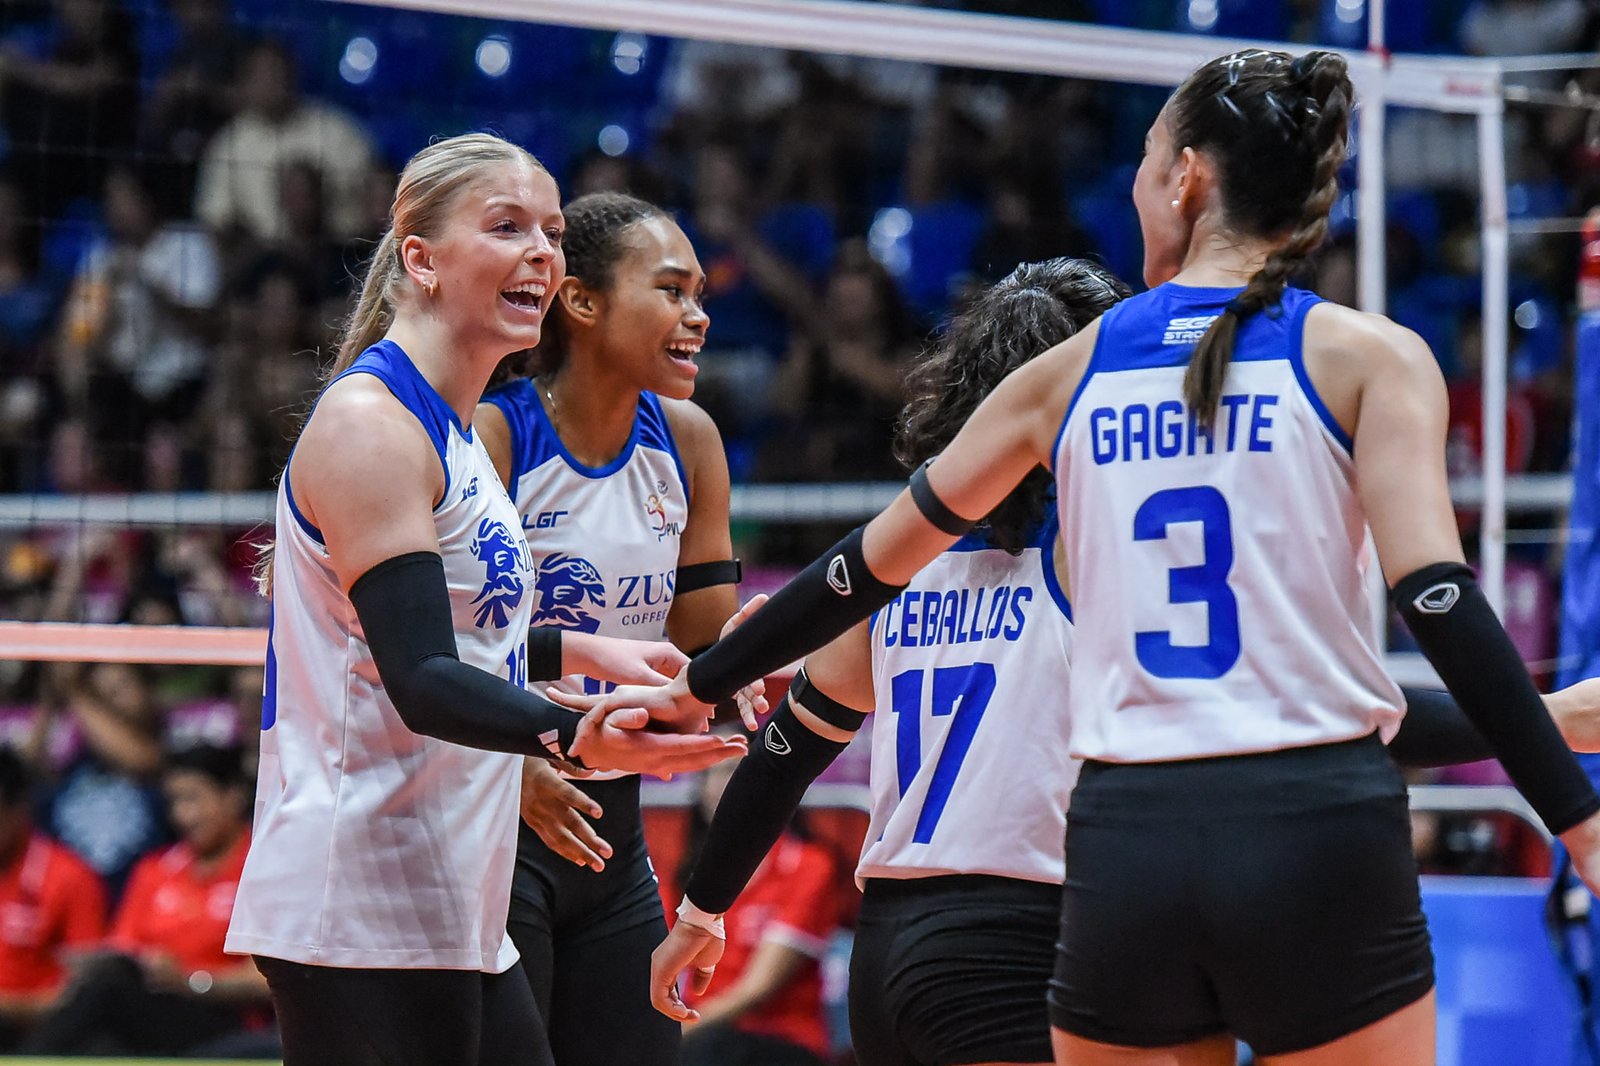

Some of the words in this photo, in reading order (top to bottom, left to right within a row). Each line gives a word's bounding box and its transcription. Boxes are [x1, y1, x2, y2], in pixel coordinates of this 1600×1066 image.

[616, 570, 675, 608] ZUS
[885, 586, 1034, 648] CEBALLOS
[1133, 485, 1241, 680] 3
[889, 662, 997, 844] 17
